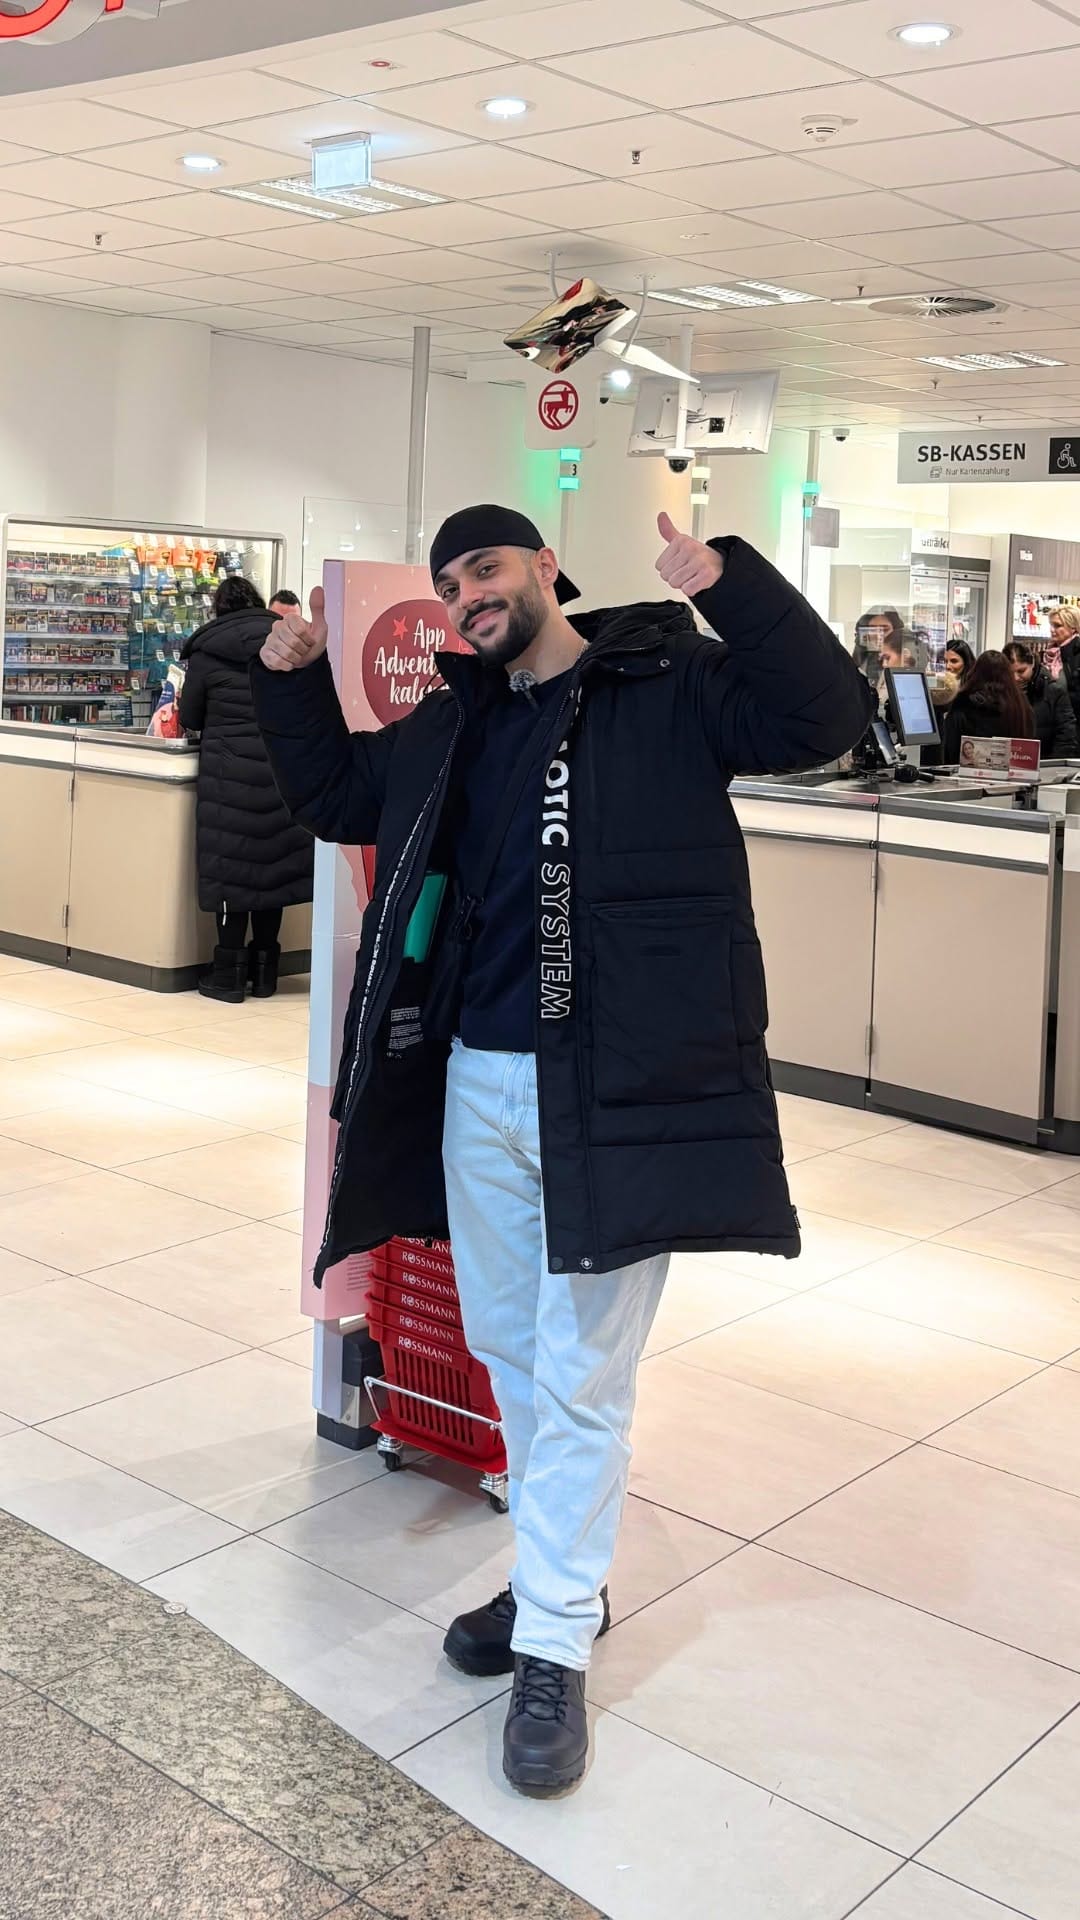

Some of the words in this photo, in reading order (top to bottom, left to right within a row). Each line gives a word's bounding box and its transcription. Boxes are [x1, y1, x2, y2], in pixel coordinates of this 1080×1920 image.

[917, 443, 1026, 463] SB-KASSEN
[571, 463, 577, 476] 3
[945, 468, 958, 476] Nur
[960, 466, 1010, 477] Kartenzahlung
[413, 618, 446, 655] App
[374, 645, 441, 678] Advent
[542, 741, 570, 847] OTIC
[541, 863, 572, 1019] SYSTEM
[402, 1271, 457, 1297] ROSSMANN
[401, 1293, 456, 1320] ROSSMANN
[399, 1314, 454, 1342] ROSSMANN
[398, 1335, 453, 1363] ROSSMANN
